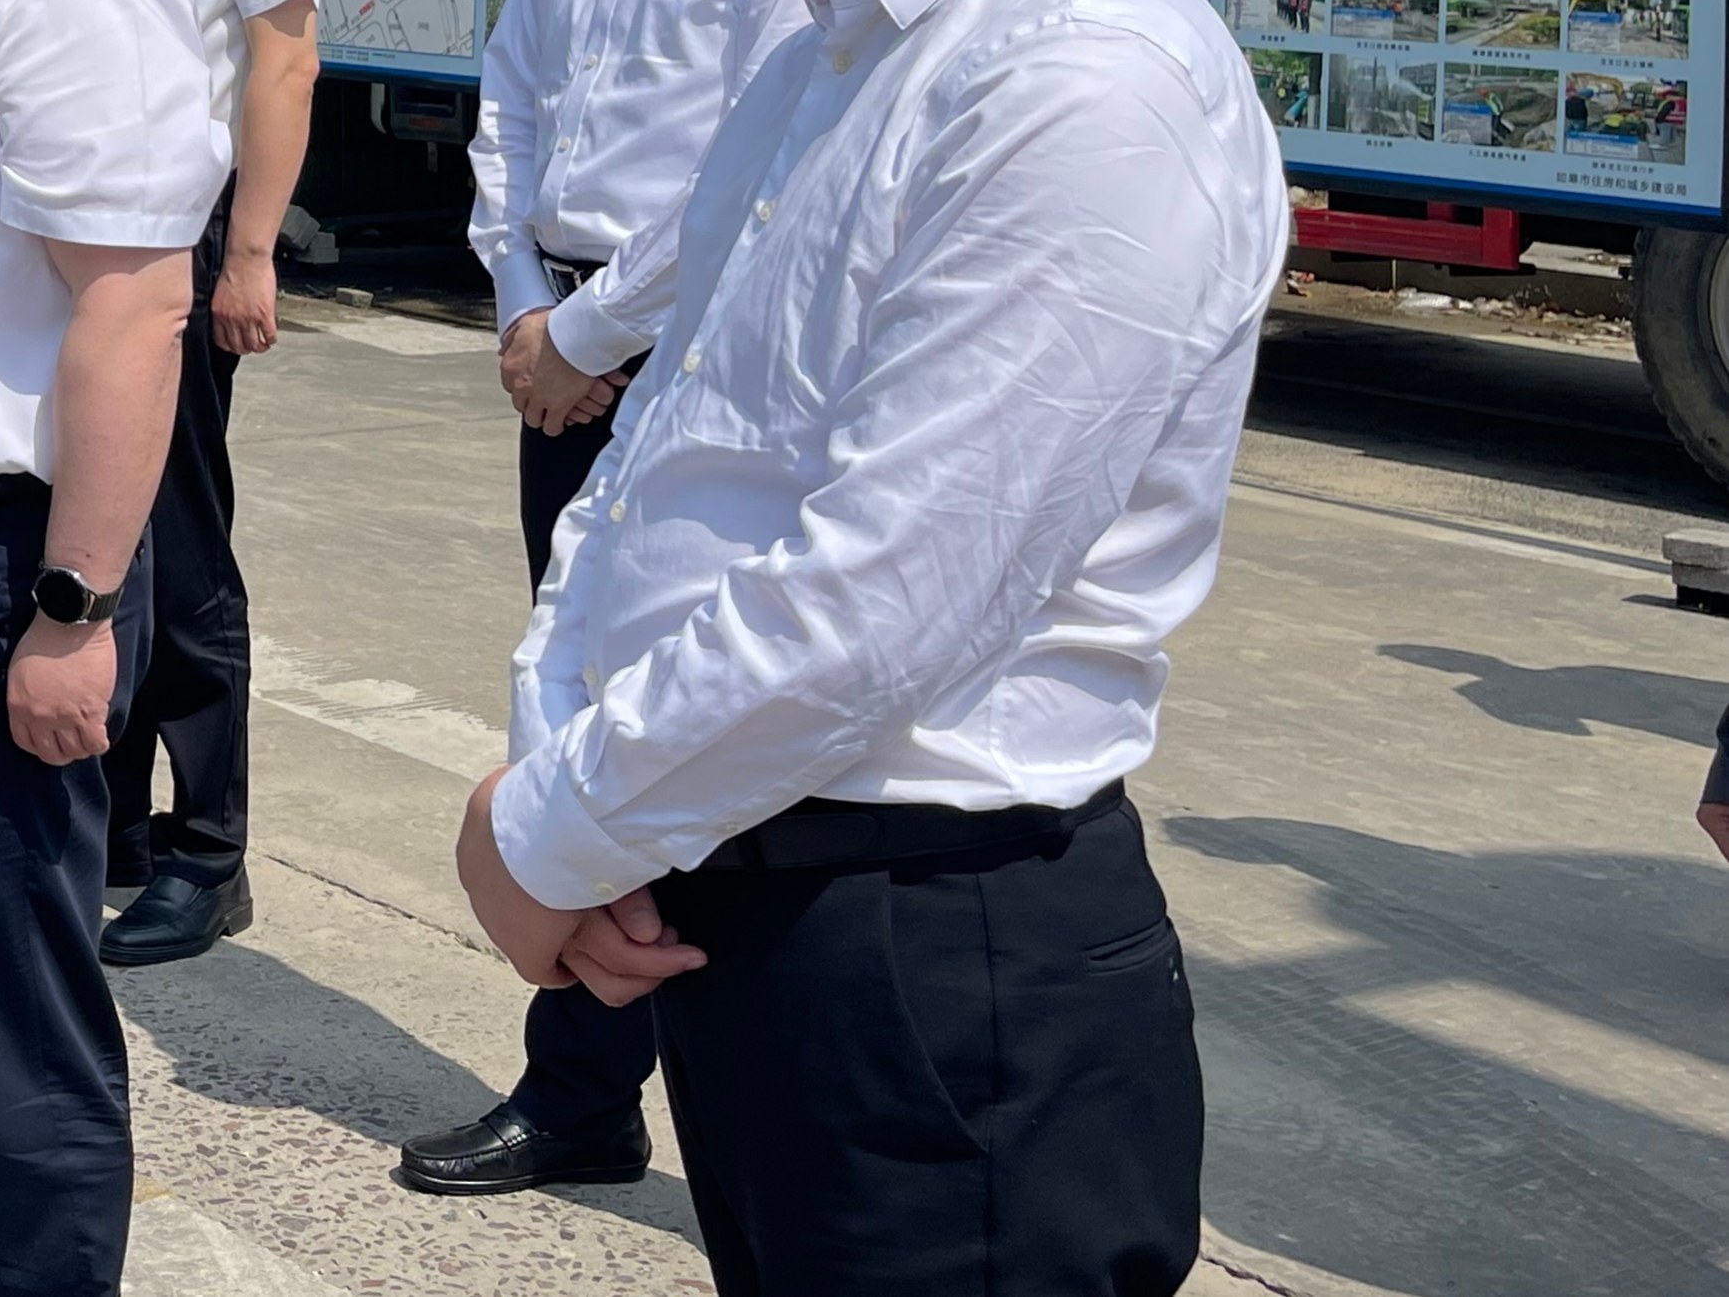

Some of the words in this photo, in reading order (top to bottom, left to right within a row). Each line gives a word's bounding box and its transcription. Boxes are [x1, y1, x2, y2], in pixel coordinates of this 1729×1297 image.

[1556, 171, 1688, 196] 如皋市住房和城乡建设局
